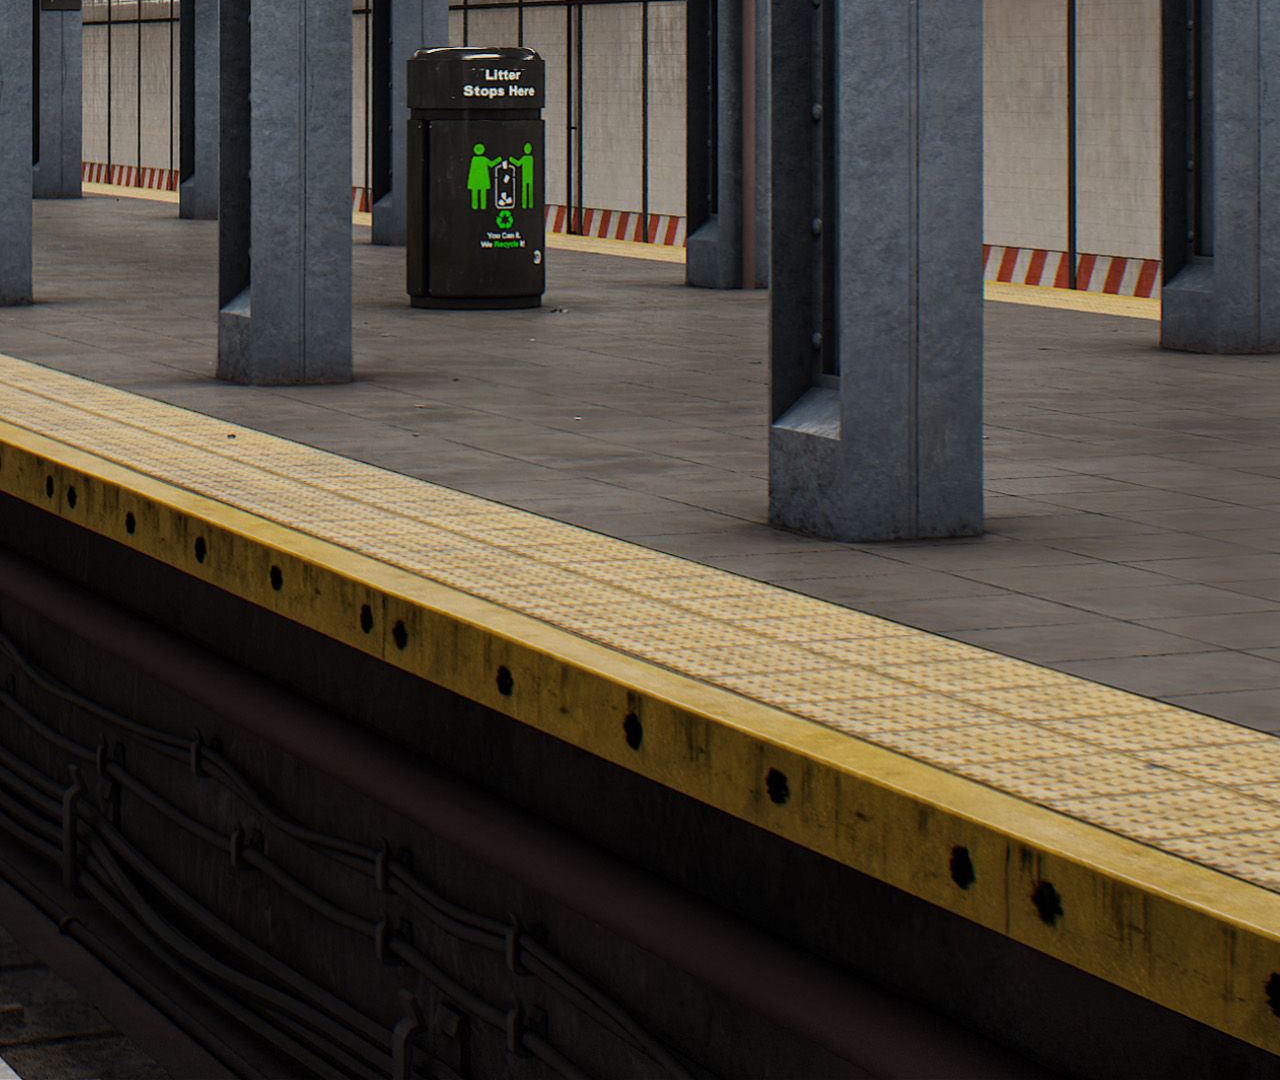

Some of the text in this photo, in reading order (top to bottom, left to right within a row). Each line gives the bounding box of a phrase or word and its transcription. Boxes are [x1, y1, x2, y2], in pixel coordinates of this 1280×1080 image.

[485, 68, 522, 81] Litter
[462, 84, 536, 100] Stops Here
